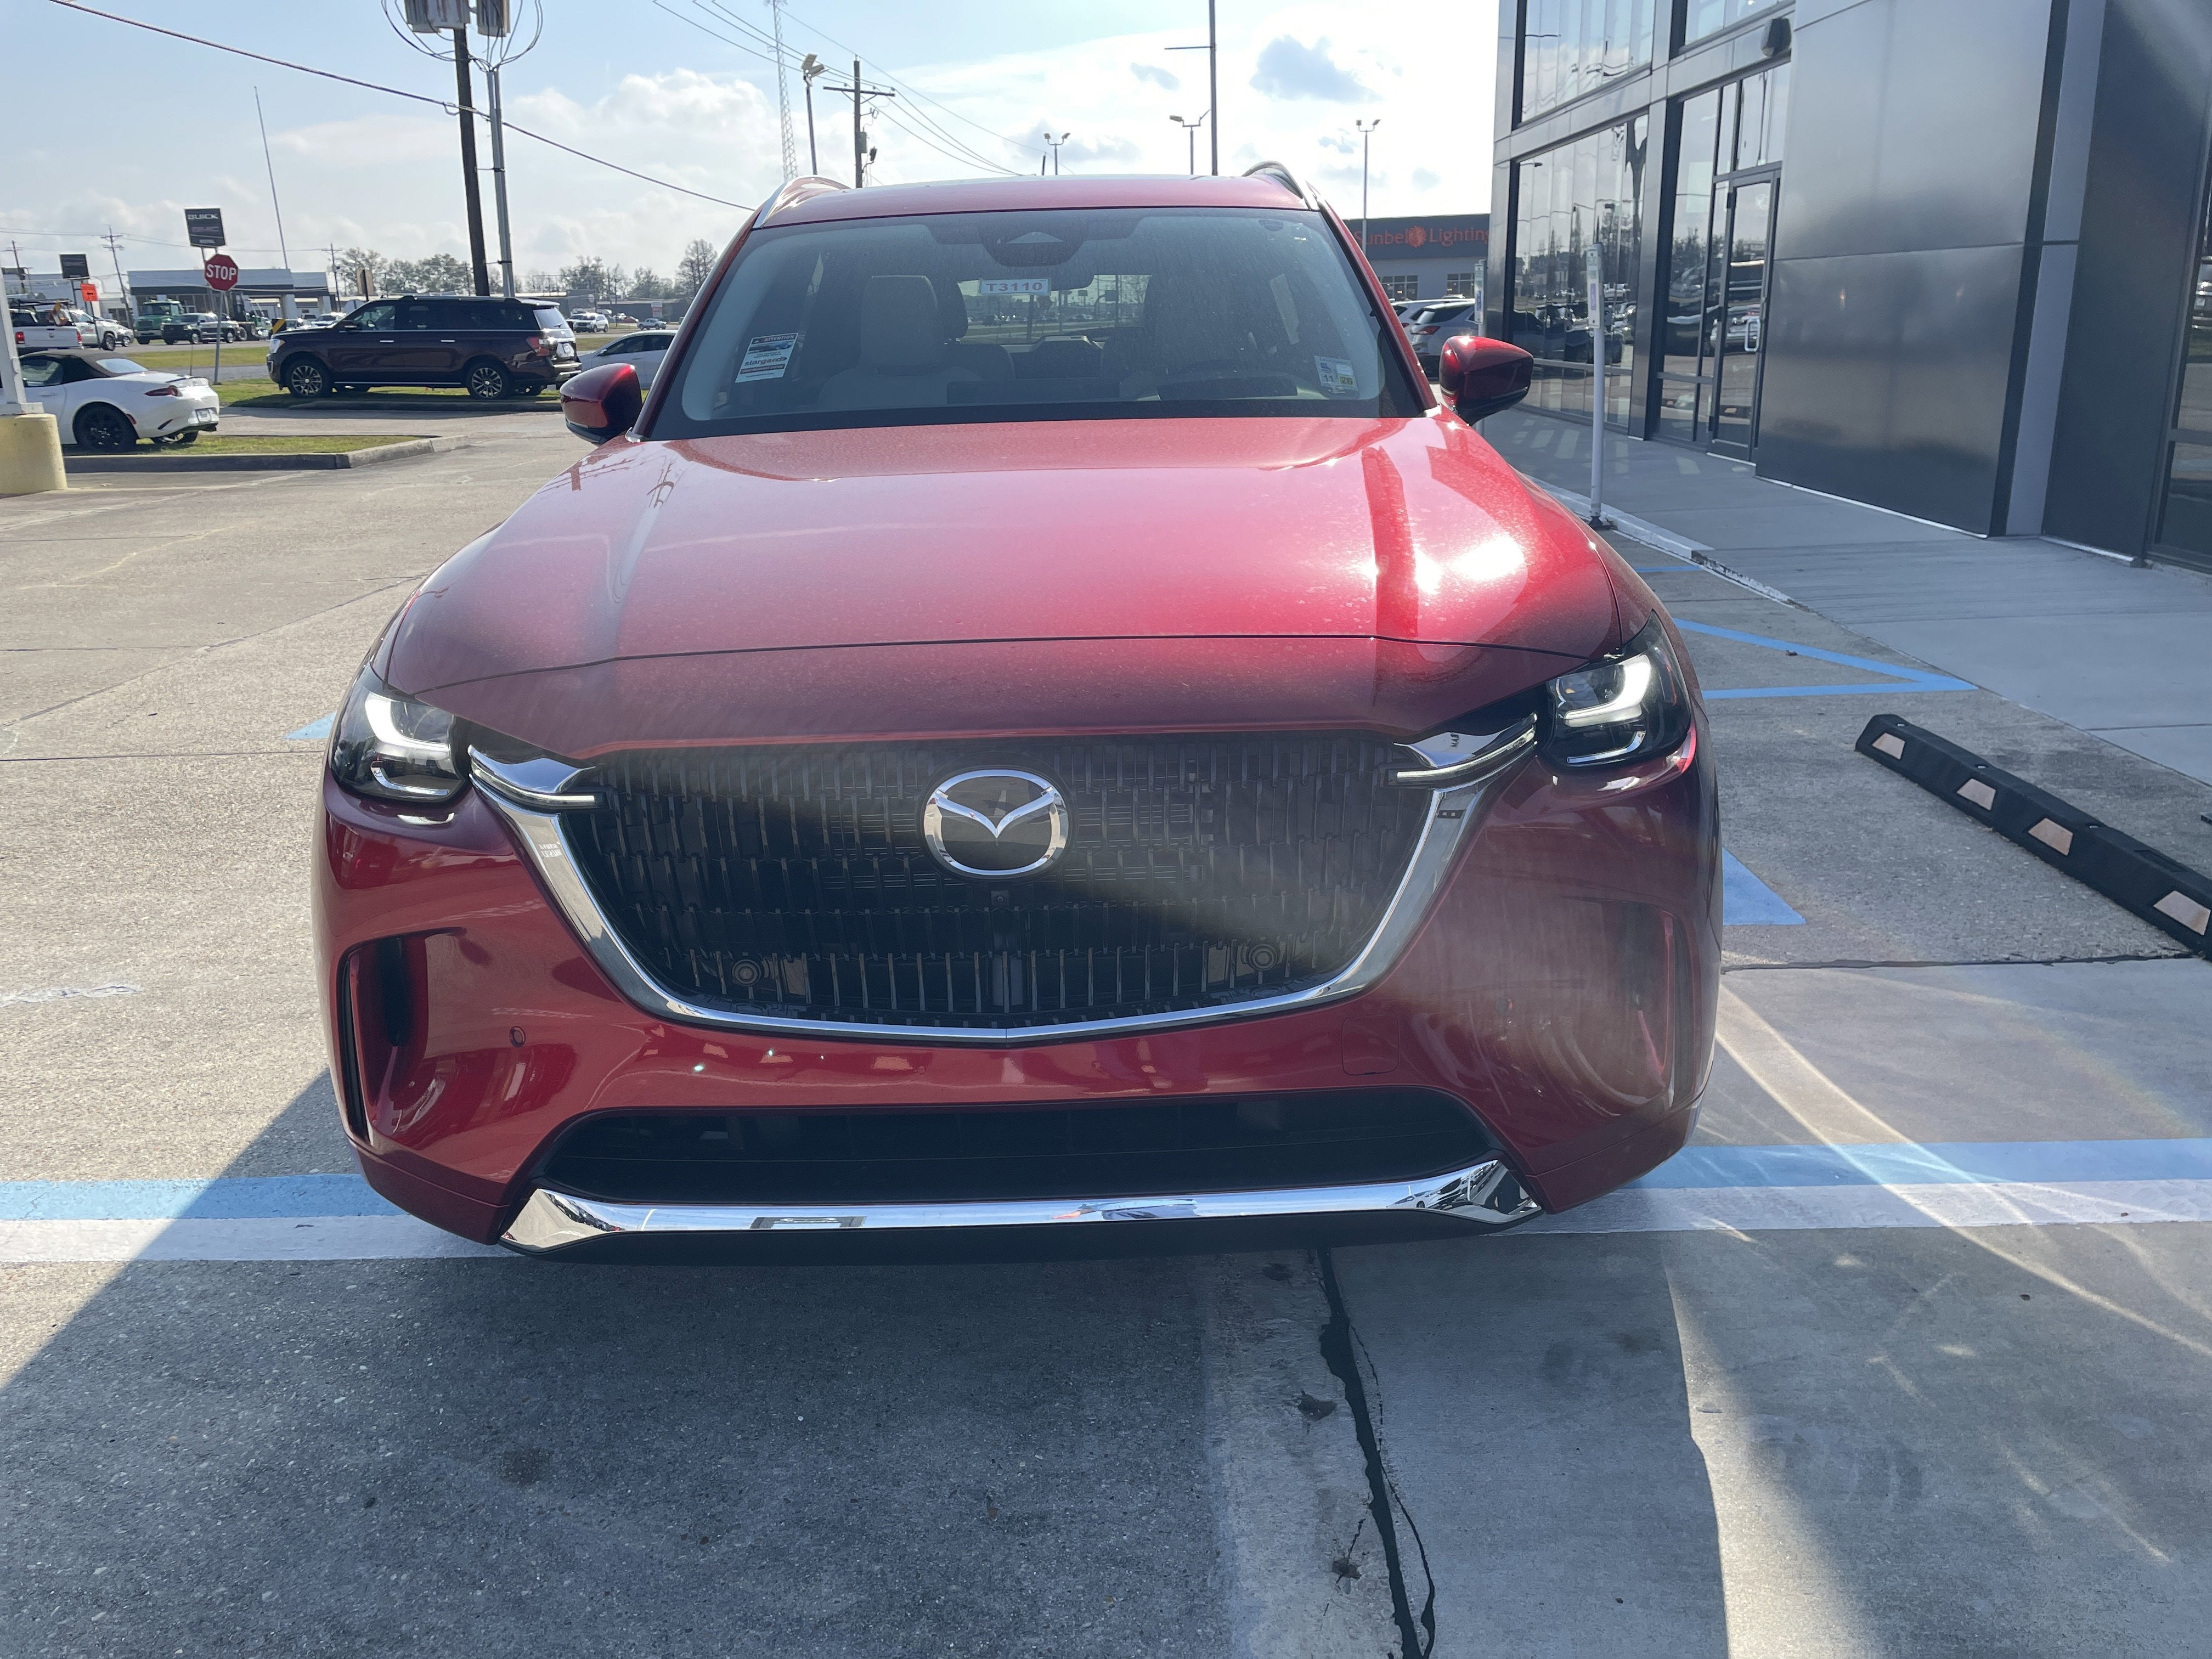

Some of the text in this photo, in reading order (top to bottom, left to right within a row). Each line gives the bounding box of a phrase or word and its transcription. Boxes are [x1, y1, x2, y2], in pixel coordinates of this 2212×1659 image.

[206, 264, 236, 280] STOP
[986, 282, 1042, 292] T3110
[1340, 376, 1353, 385] 26
